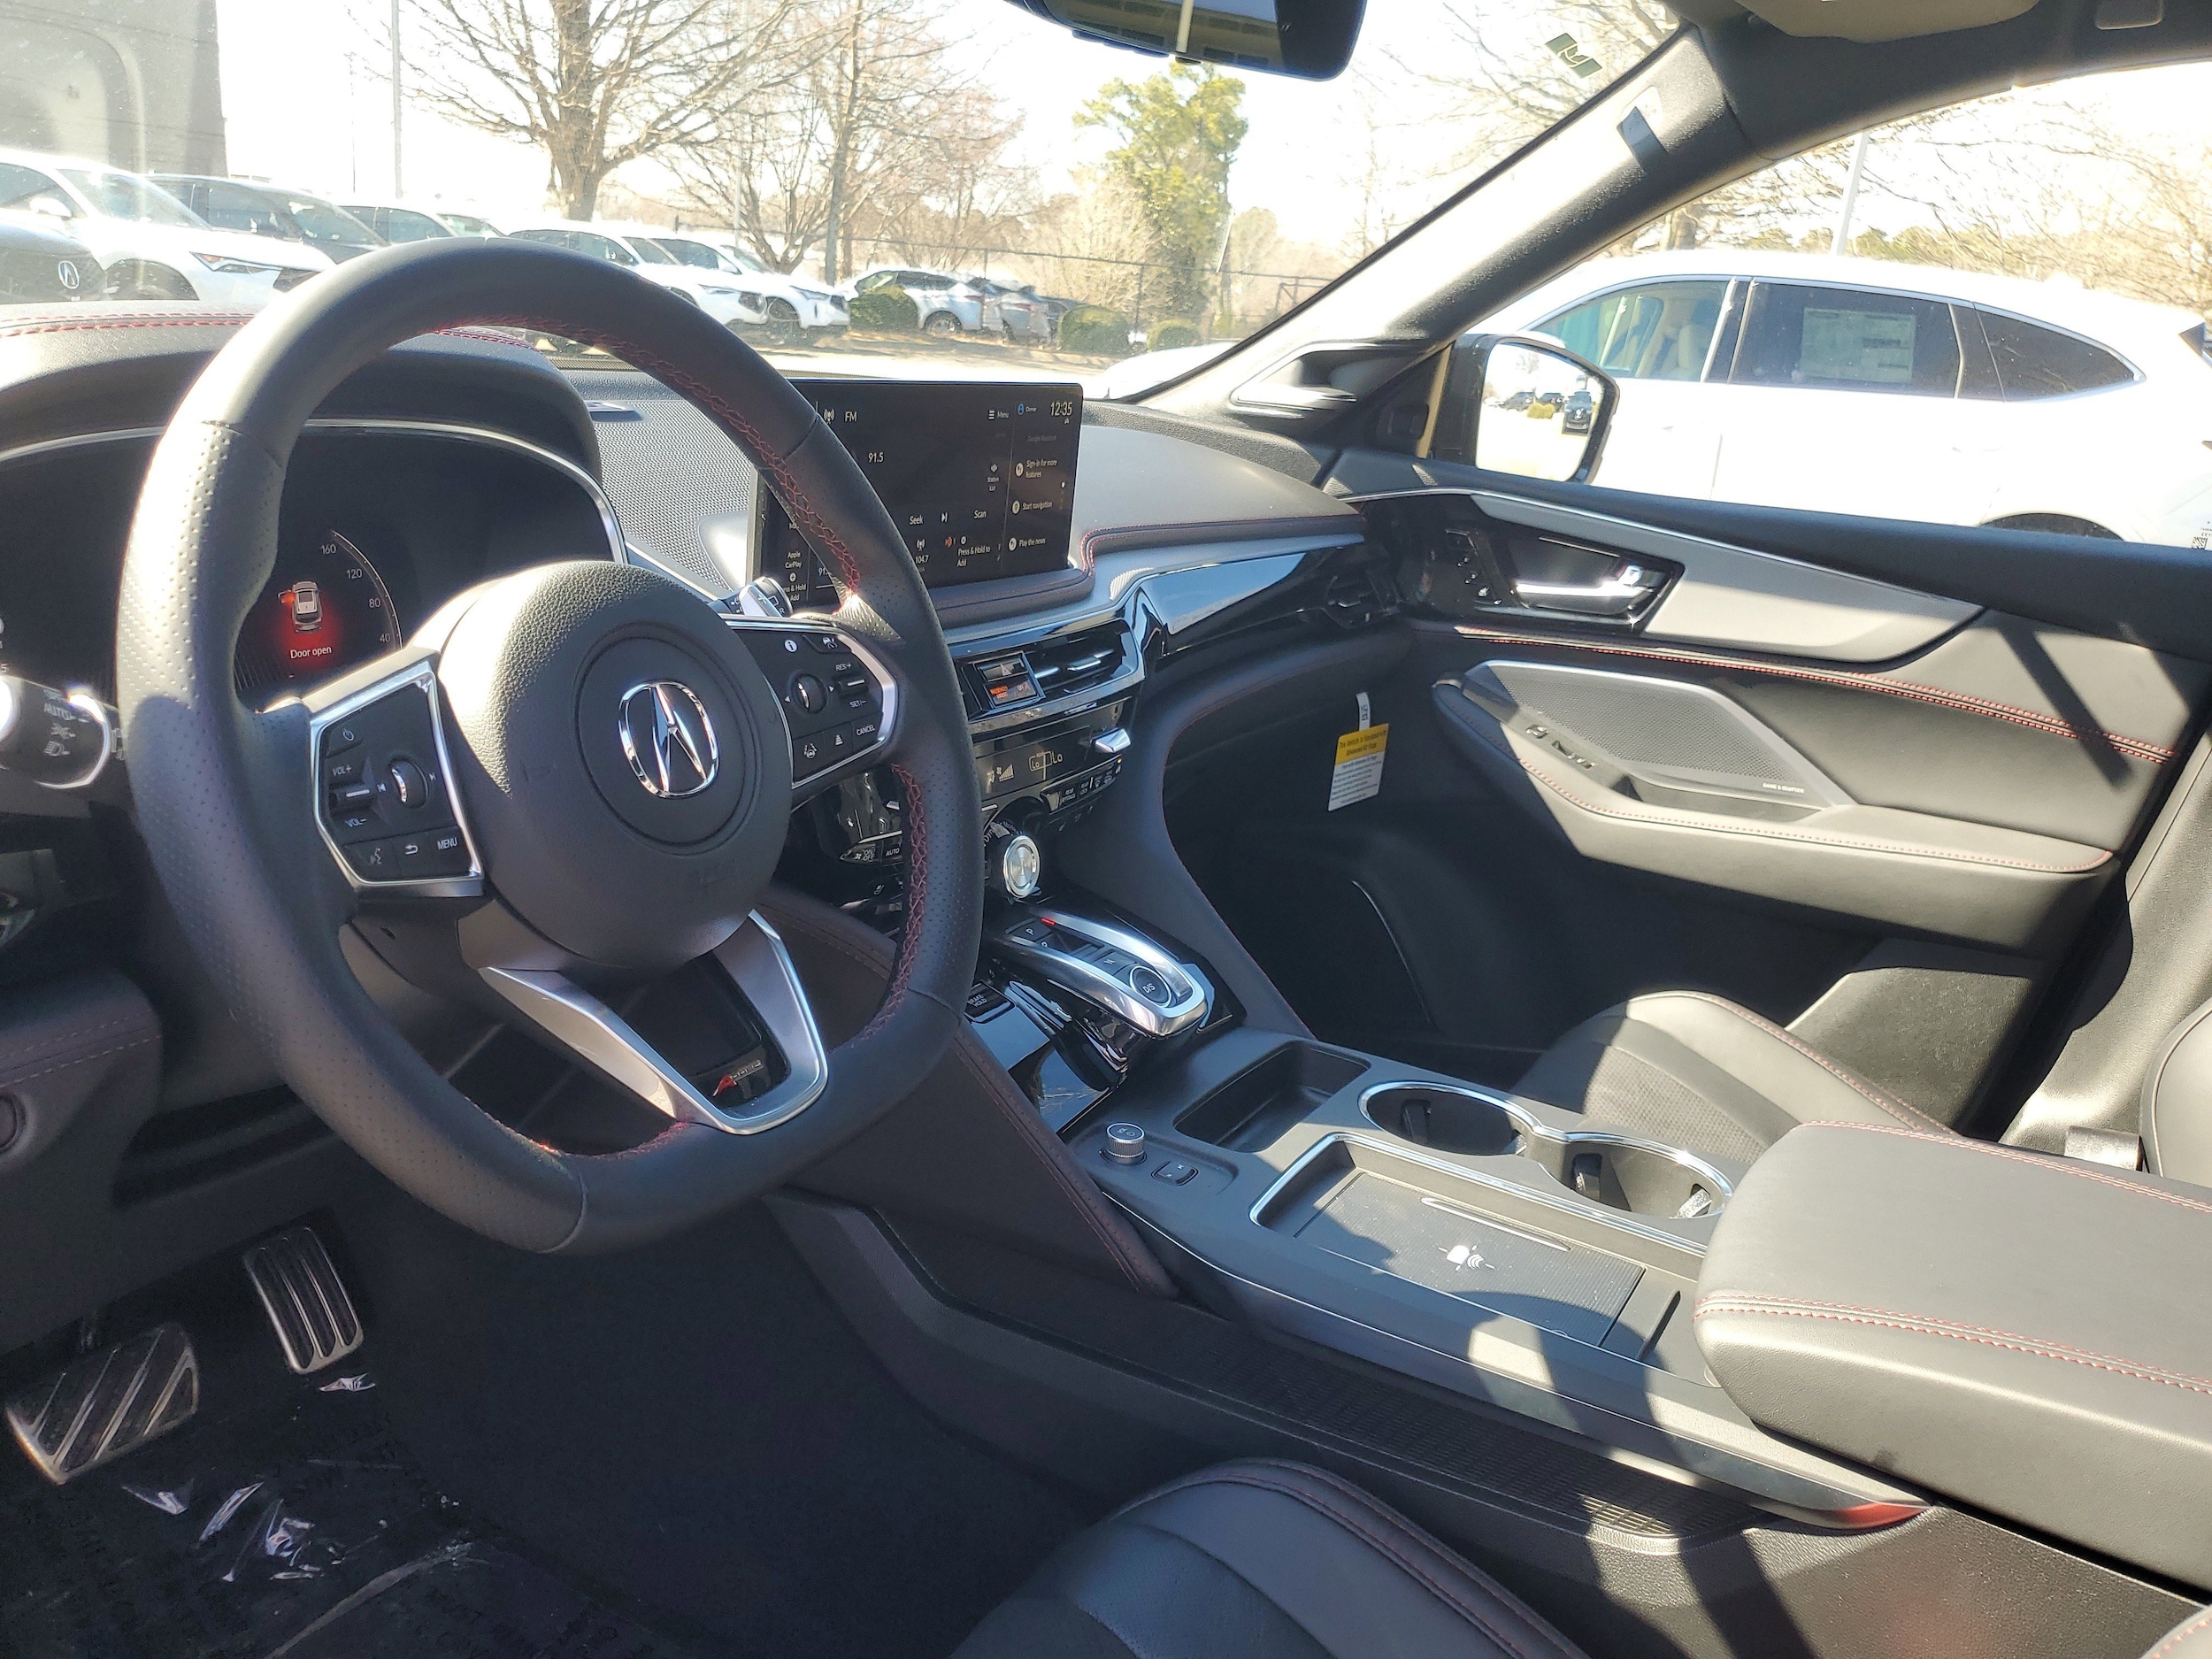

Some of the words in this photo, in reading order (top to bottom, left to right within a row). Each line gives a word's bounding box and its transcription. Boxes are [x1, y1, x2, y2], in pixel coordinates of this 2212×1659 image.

[1049, 401, 1073, 417] 12:35
[844, 411, 857, 423] FM
[868, 452, 885, 463] 91.5
[1022, 502, 1033, 511] Start
[1032, 500, 1053, 511] navigation
[973, 510, 987, 519] Scan
[909, 515, 924, 526] Seek
[1018, 539, 1028, 548] Play
[321, 544, 337, 555] 160
[787, 550, 802, 559] Apple
[974, 545, 986, 554] Hold
[915, 554, 930, 565] 104.7
[956, 558, 967, 567] Add
[346, 568, 363, 580] 120
[369, 598, 381, 609] 80
[380, 633, 392, 643] 40
[289, 649, 311, 659] Door
[311, 645, 333, 657] open
[856, 725, 876, 736] CANCEL
[1053, 752, 1063, 764] Lo
[332, 764, 352, 776] VOL+
[1031, 760, 1040, 770] Lo
[344, 818, 367, 828] VOL-
[437, 837, 458, 850] MENU
[885, 847, 901, 857] AUTO
[1142, 982, 1156, 994] D/S
[967, 994, 984, 1005] BRAKE
[972, 998, 987, 1008] HOLD
